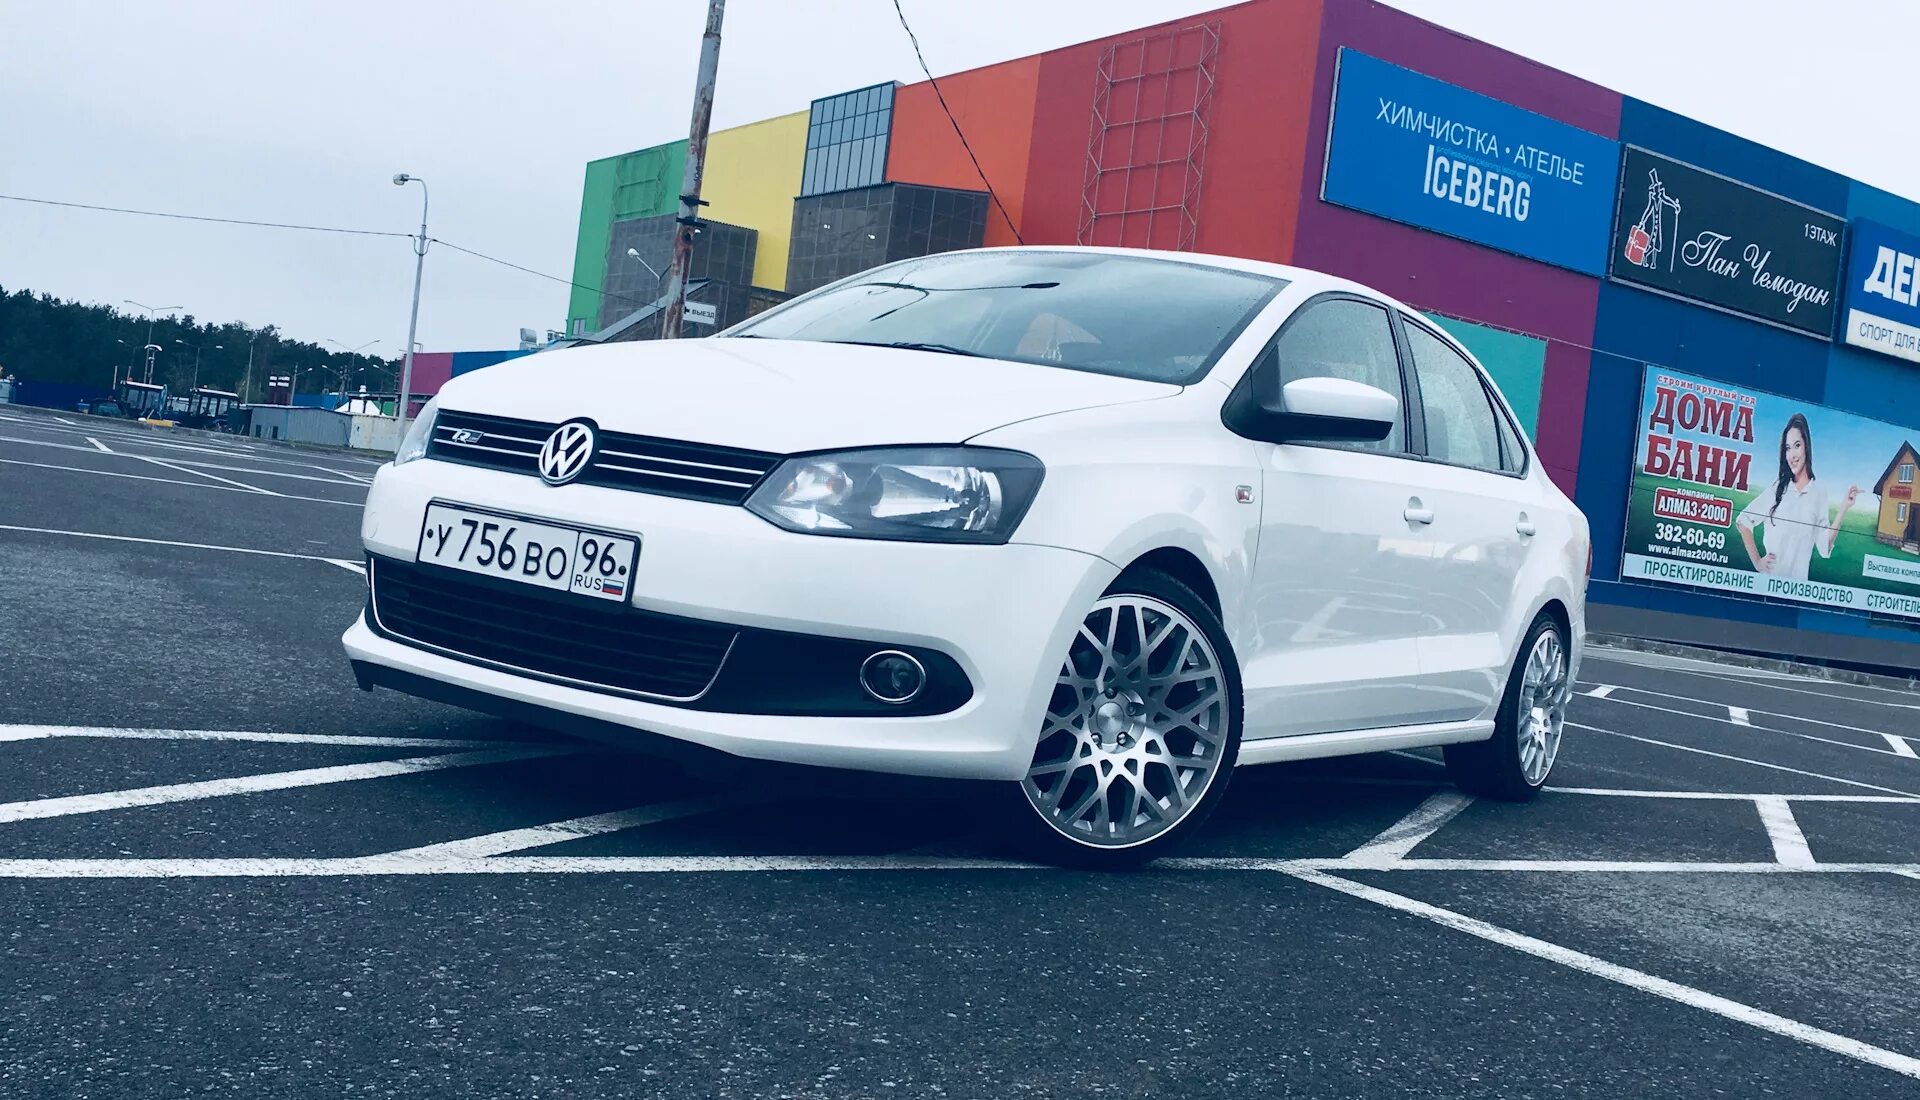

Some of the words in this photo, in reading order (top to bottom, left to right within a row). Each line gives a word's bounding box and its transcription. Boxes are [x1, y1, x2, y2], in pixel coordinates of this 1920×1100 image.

[1376, 97, 1499, 158] ХИМЧИСТКА
[1513, 144, 1585, 185] АТЕЛЬЕ
[1681, 231, 1740, 279] Пан
[1743, 243, 1830, 313] Чемодан
[1860, 322, 1893, 343] СПОРТ
[1895, 332, 1916, 352] ДЛЯ
[1649, 386, 1754, 443] ДОМА
[1644, 434, 1752, 491] БАНИ
[458, 518, 518, 571] 756
[1647, 543, 1729, 563] www.almaz2000.ru
[1655, 522, 1726, 550] 382-60-69
[581, 538, 617, 576] 96
[1867, 560, 1900, 575] Выставка
[574, 574, 602, 590] RUS
[1644, 560, 1755, 589] ПРОЕКТИРОВАНИЕ
[1767, 578, 1853, 604] ПРОИЗВОДСТВО
